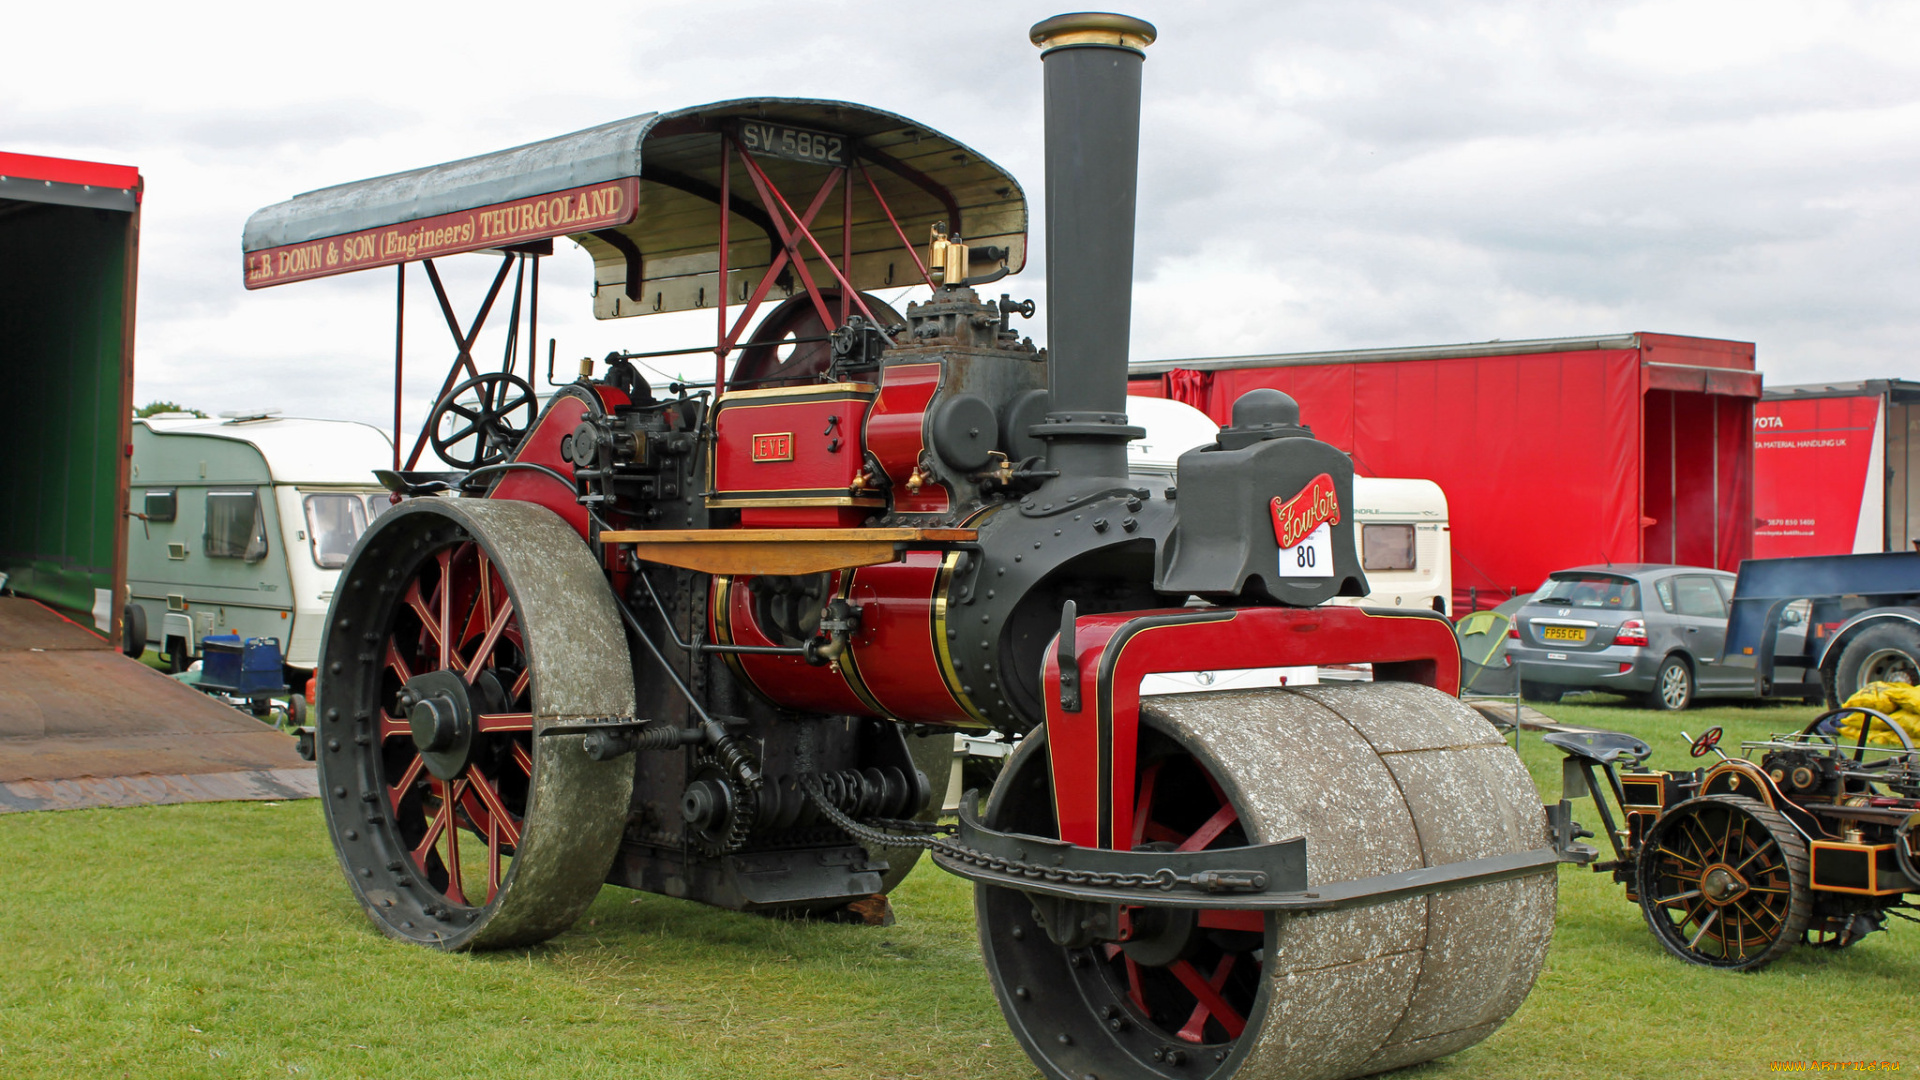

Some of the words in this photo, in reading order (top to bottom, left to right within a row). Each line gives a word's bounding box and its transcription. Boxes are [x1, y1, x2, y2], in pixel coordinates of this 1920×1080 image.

[743, 123, 775, 151] SV
[781, 129, 842, 162] 5862
[278, 243, 323, 275] DONN
[326, 241, 339, 265] &
[343, 233, 377, 262] SON
[380, 215, 476, 259] (Engineers)
[479, 185, 625, 238] THURGOLAND
[759, 438, 787, 457] EVE
[1763, 440, 1797, 449] MATERIAL
[1797, 438, 1835, 448] HANDLING
[1836, 438, 1847, 447] UK
[1278, 484, 1338, 548] Fowler
[1296, 545, 1316, 568] 80
[1545, 627, 1567, 639] FP55
[1567, 629, 1585, 640] CFL
